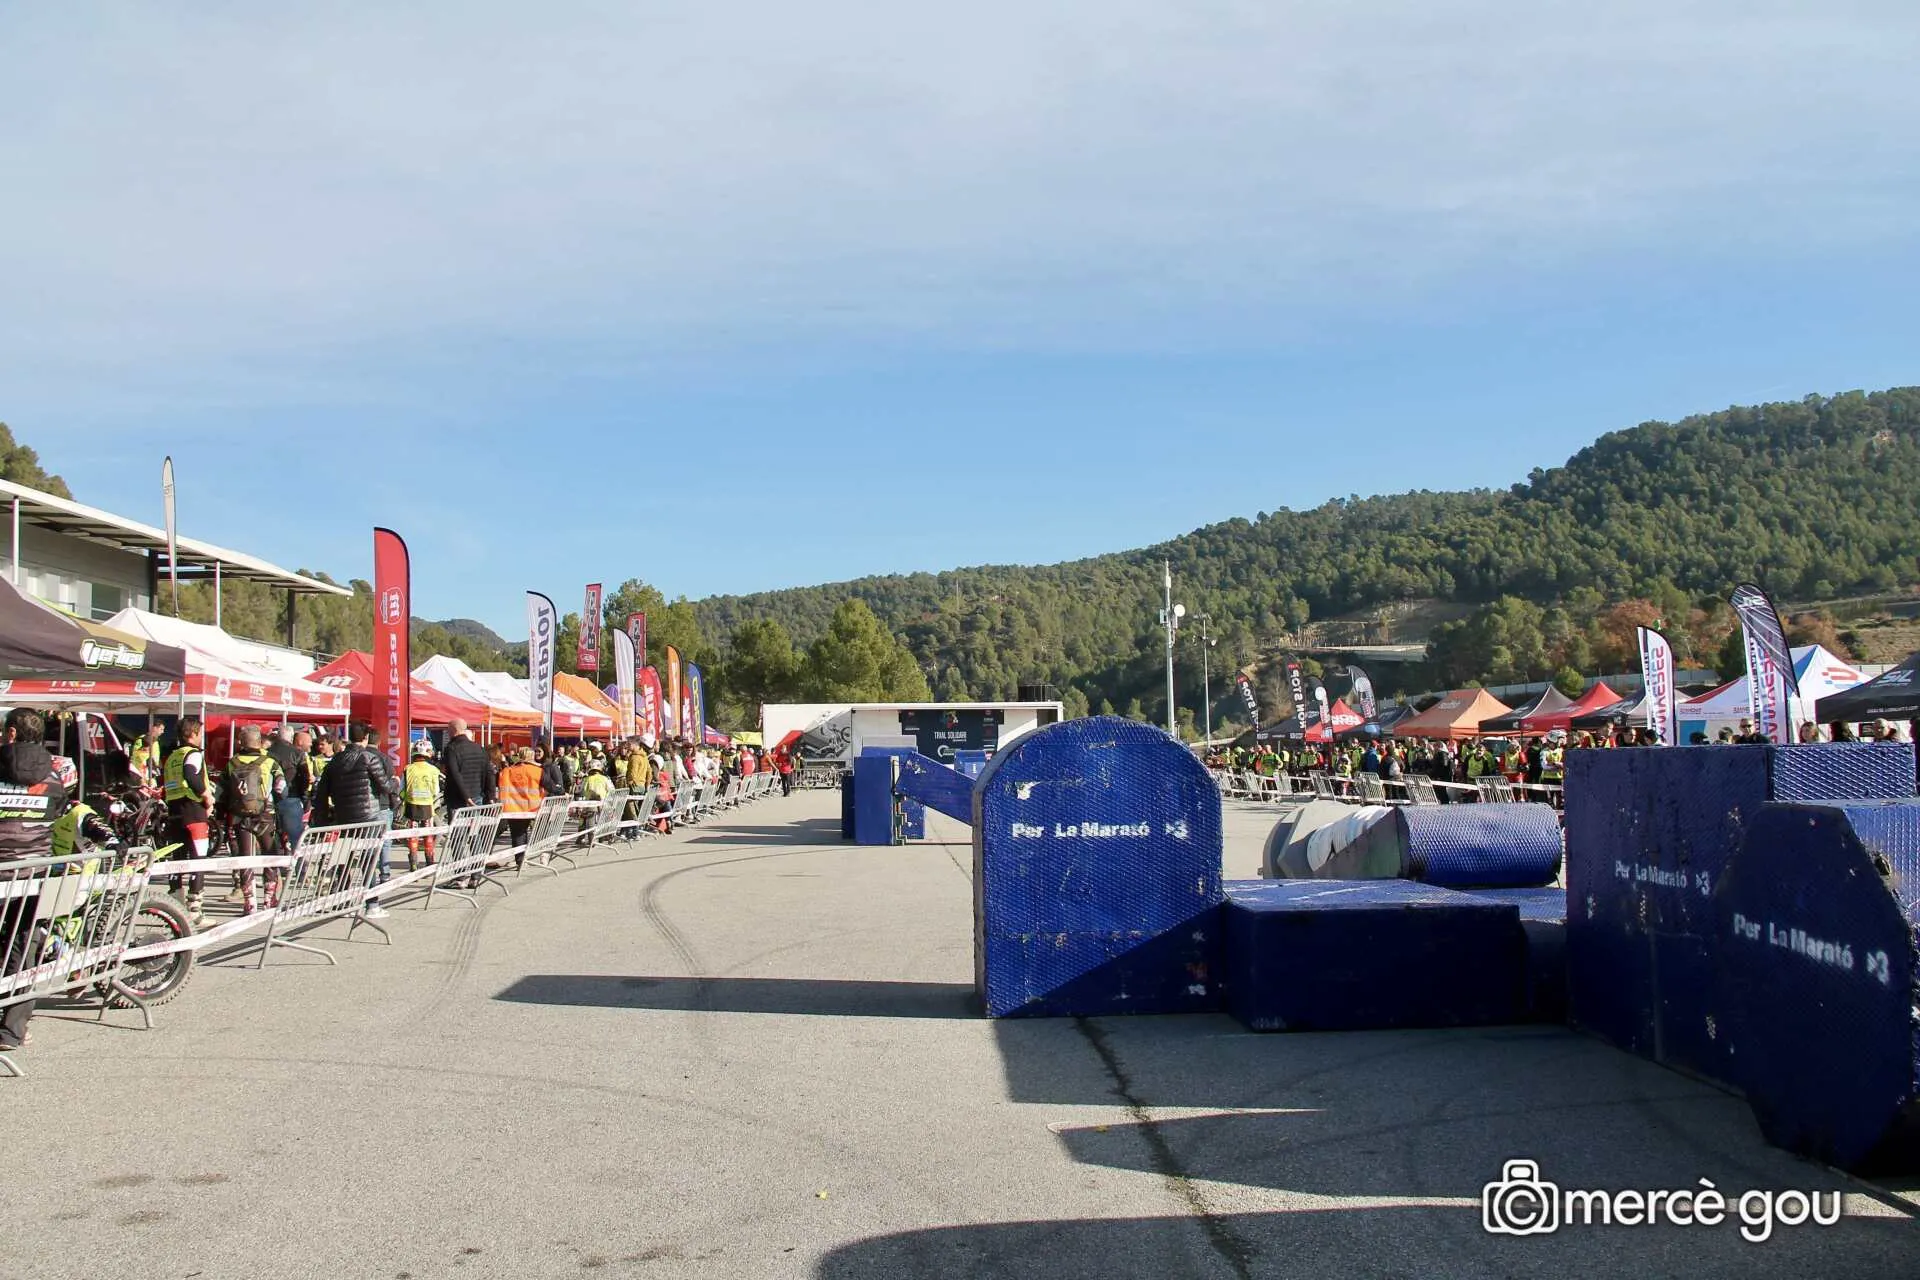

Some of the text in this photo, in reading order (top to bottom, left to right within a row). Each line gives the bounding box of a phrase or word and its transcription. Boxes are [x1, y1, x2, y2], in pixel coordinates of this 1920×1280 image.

[1012, 822, 1044, 838] Per
[1055, 822, 1078, 838] La
[1080, 821, 1150, 838] Marató
[1615, 860, 1630, 880] Per
[1635, 863, 1647, 882] La
[1649, 865, 1687, 889] Marató
[1733, 912, 1761, 941] Per
[1769, 921, 1788, 948] La
[1790, 927, 1855, 970] Marató
